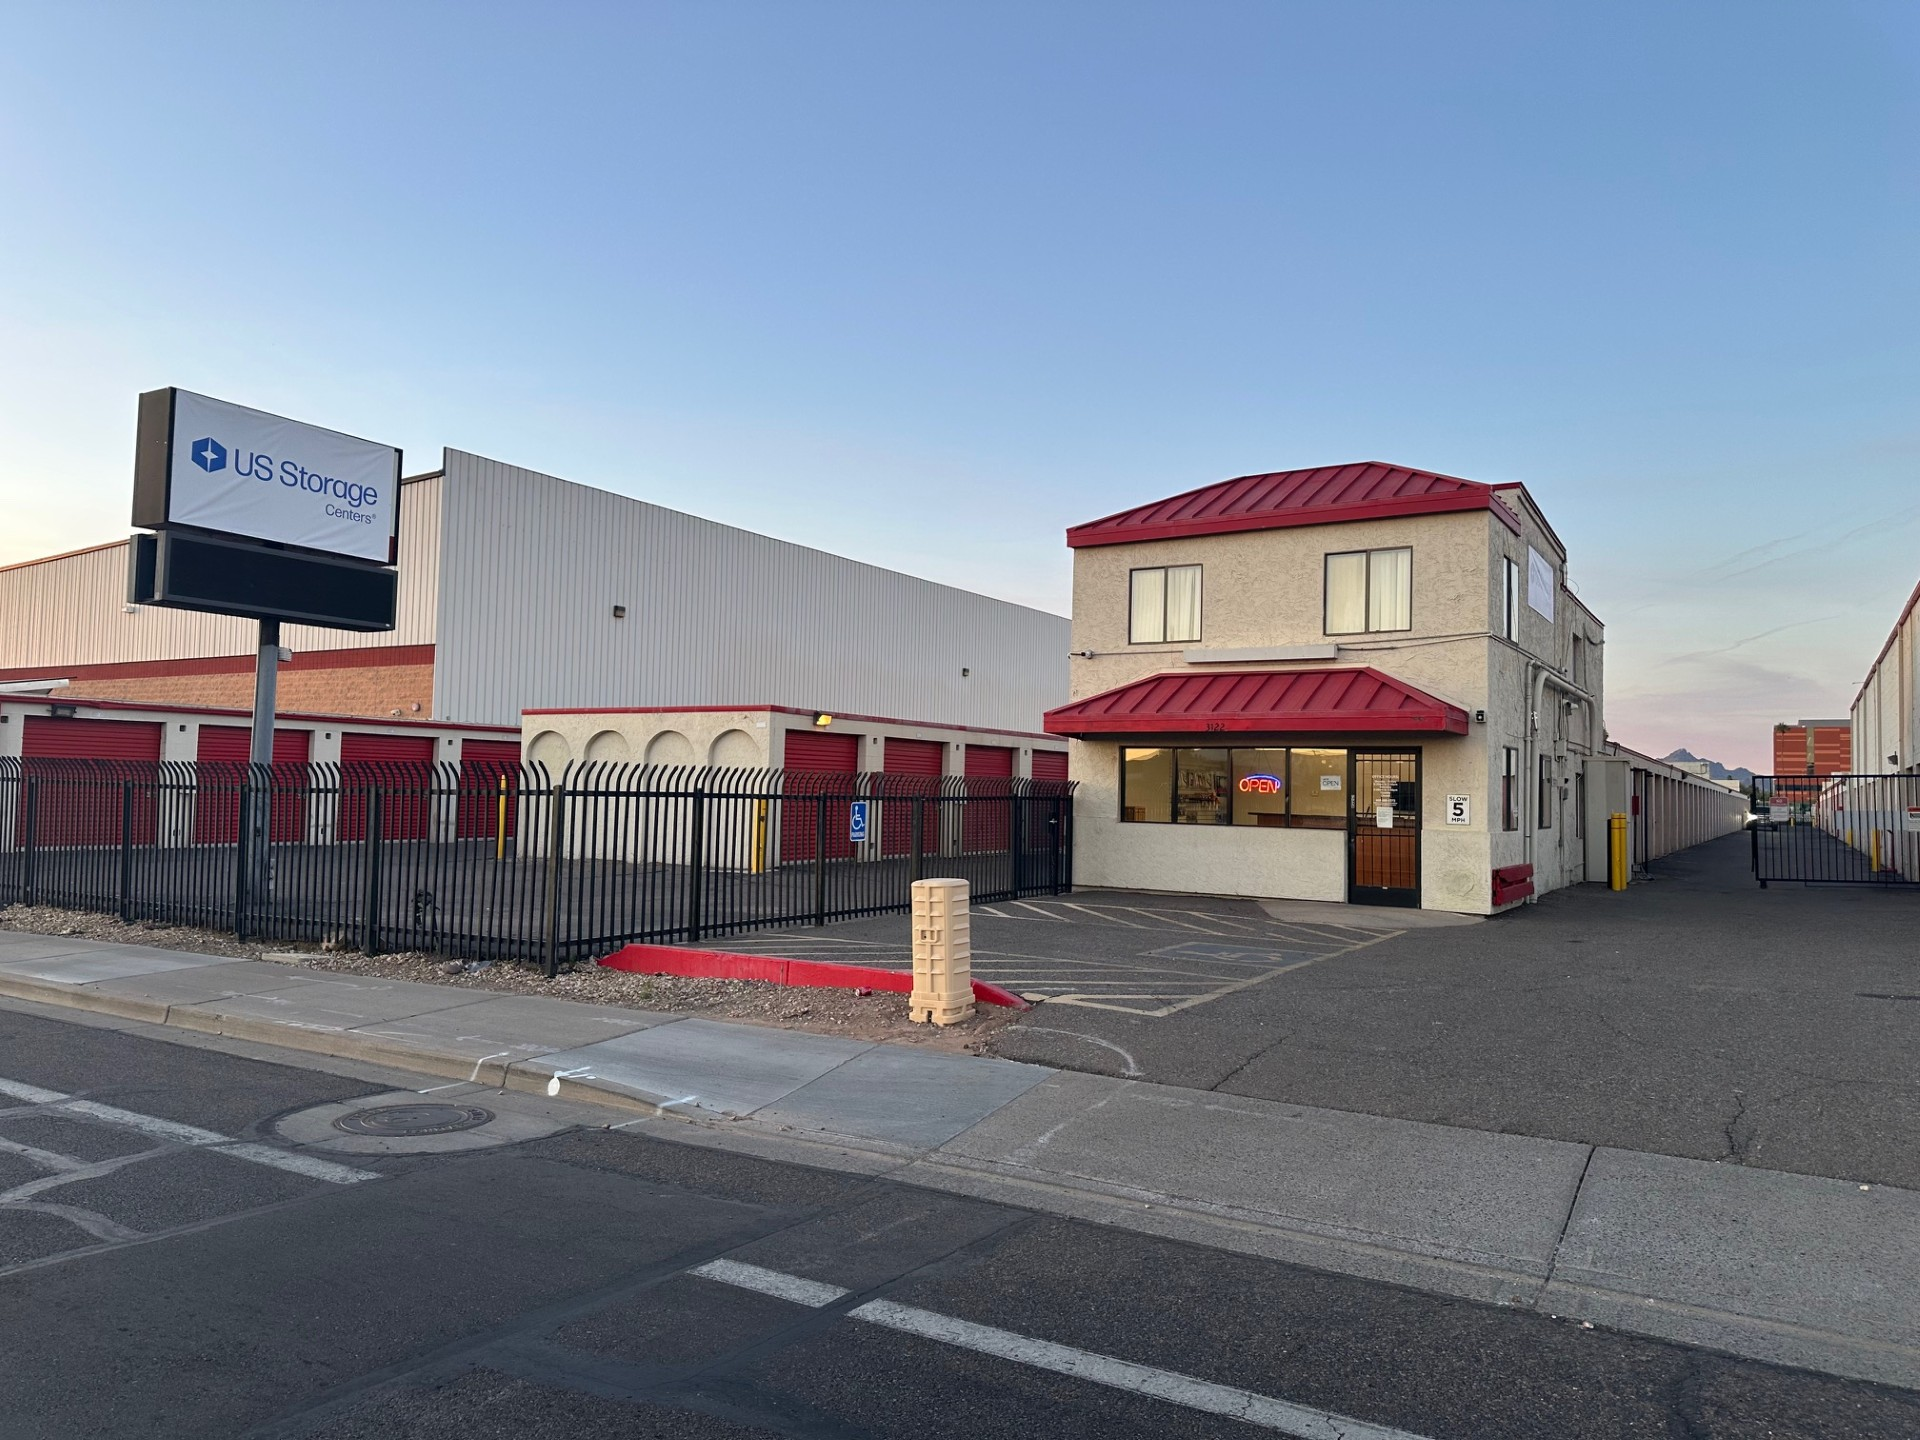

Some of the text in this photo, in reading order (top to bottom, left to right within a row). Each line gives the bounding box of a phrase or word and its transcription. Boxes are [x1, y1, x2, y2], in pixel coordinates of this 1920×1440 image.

[235, 449, 377, 507] US Storage
[1206, 722, 1226, 732] 3122
[1239, 778, 1278, 794] OPEN
[1452, 802, 1464, 817] 5
